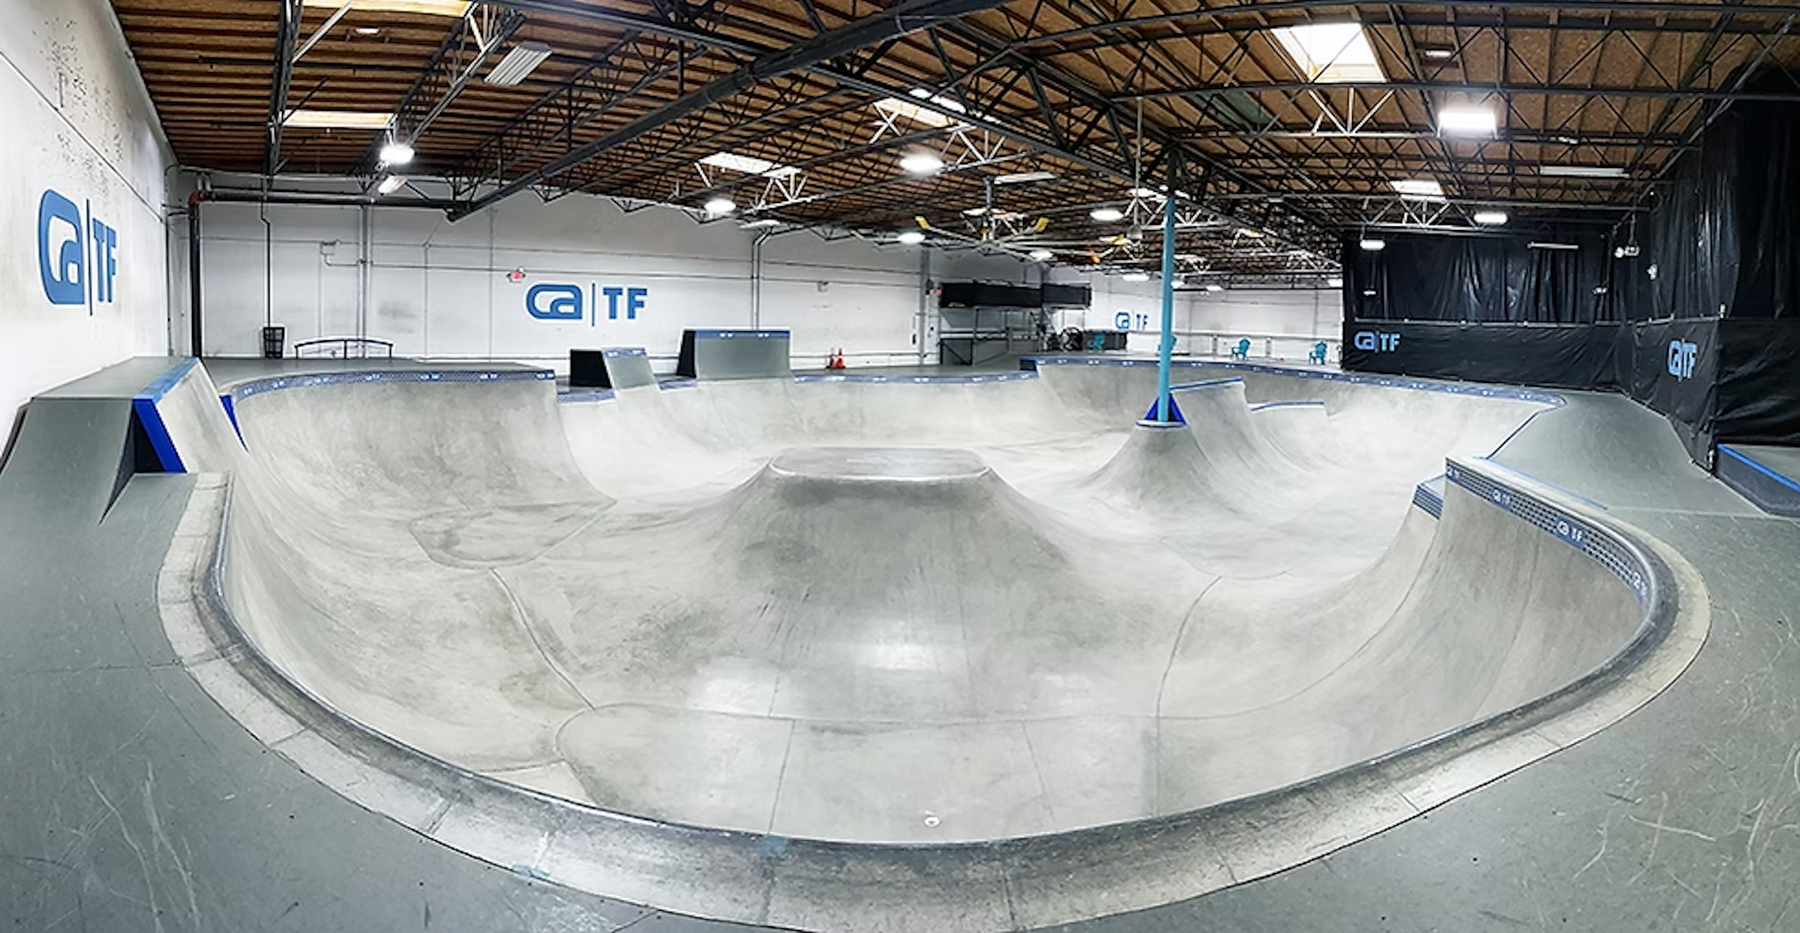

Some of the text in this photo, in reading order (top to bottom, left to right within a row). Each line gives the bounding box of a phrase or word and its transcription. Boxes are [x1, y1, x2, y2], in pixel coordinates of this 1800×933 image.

[92, 218, 117, 303] TF
[603, 287, 648, 319] TF
[1136, 314, 1149, 330] TF
[1380, 333, 1400, 352] TF
[1682, 342, 1698, 379] TF
